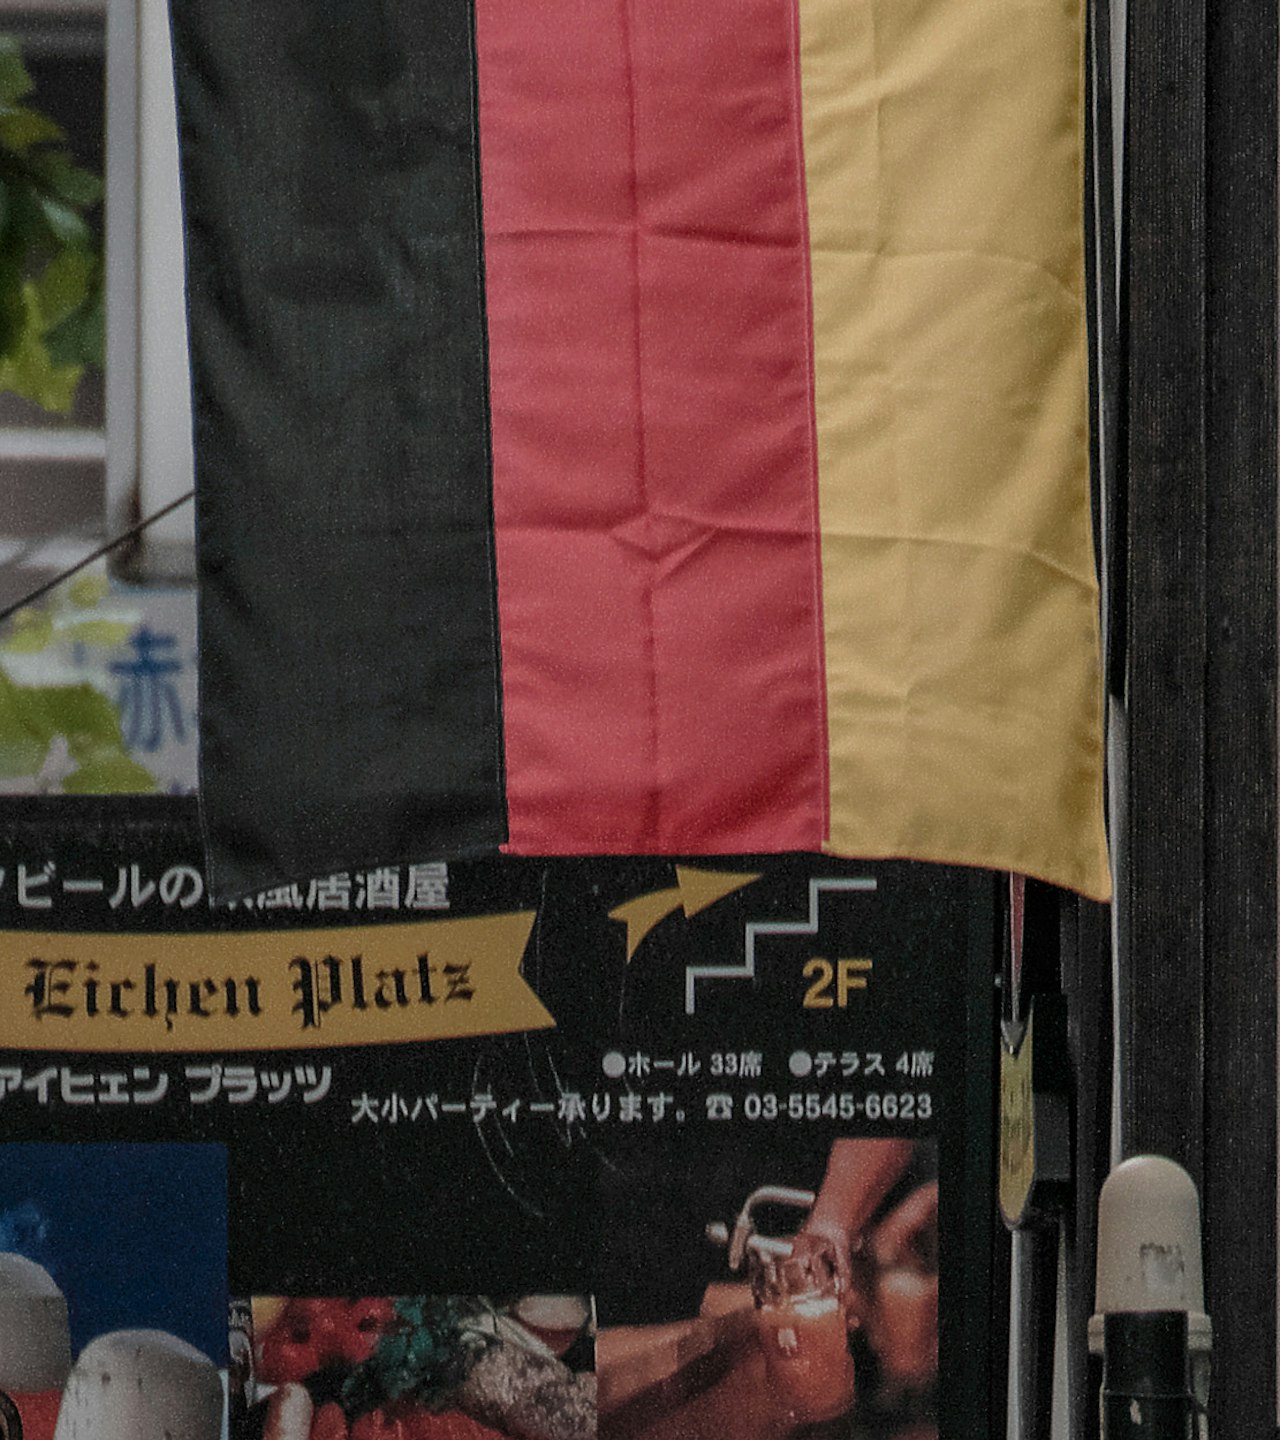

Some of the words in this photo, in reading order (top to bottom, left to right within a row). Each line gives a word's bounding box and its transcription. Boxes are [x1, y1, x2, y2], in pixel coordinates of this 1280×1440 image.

[24, 956, 264, 1032] Eichen
[288, 952, 476, 1030] Platz
[801, 958, 873, 1009] 2F
[627, 1050, 702, 1079] ホール
[709, 1050, 764, 1078] 33席
[813, 1050, 887, 1078] テラス
[895, 1050, 935, 1078] 4席
[743, 1093, 934, 1121] 03-5545-6623
